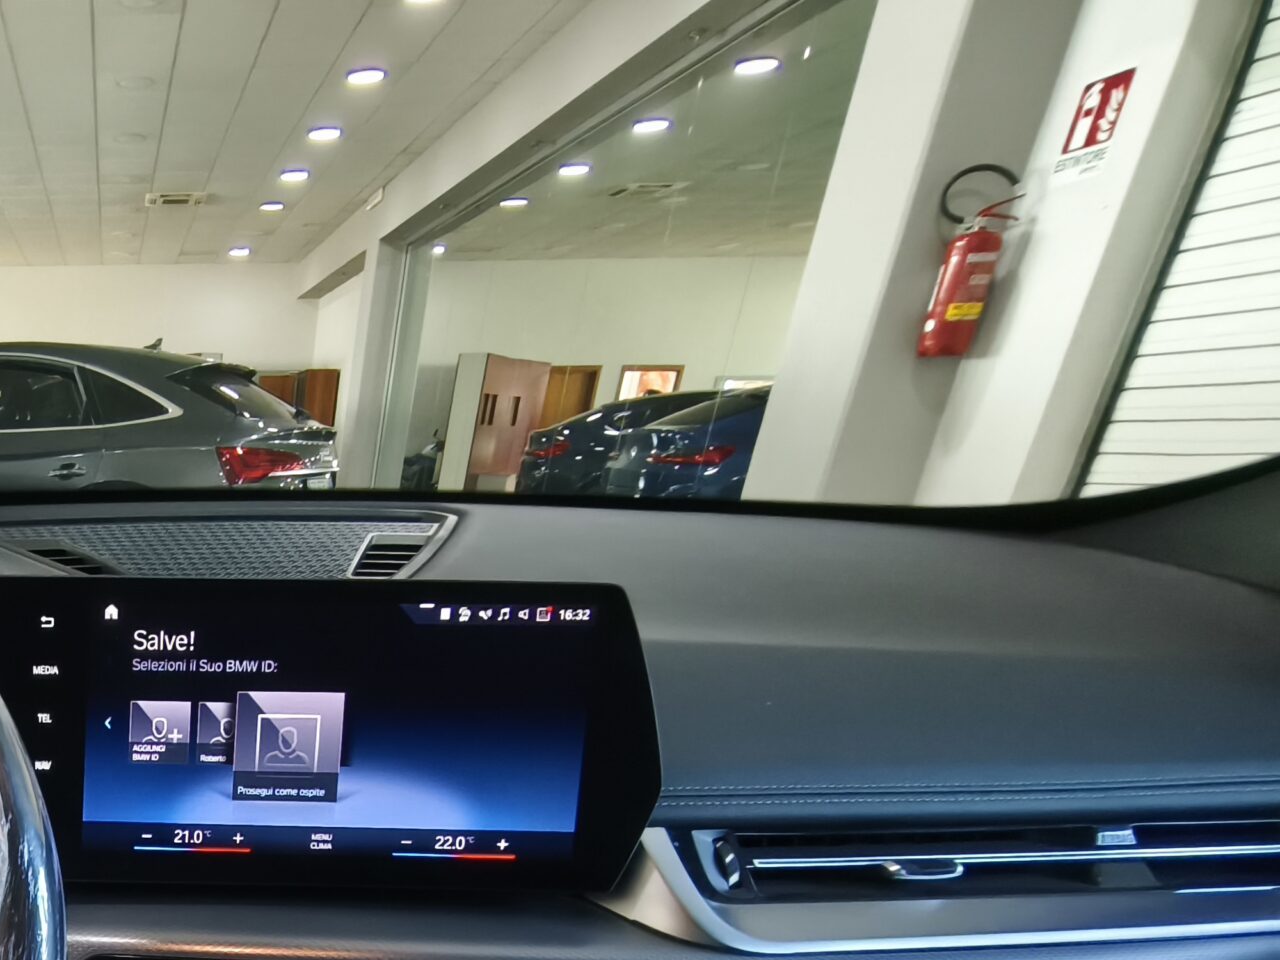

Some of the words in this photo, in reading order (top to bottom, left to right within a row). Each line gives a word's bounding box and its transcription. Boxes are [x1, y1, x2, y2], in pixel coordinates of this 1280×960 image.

[559, 609, 591, 620] 16:32
[133, 629, 196, 651] Salve!
[32, 665, 59, 675] MEDIA
[132, 658, 187, 671] Selezioni
[189, 659, 197, 671] il
[199, 659, 223, 672] Suo
[225, 660, 258, 672] BMW
[261, 660, 278, 673] ID:
[37, 713, 53, 723] TEL
[132, 753, 151, 761] BMW
[151, 753, 160, 761] ID
[237, 785, 273, 797] Prosegui
[275, 787, 298, 796] come
[299, 787, 325, 797] ospite
[173, 829, 203, 844] 21.0
[311, 833, 333, 841] MENU
[310, 842, 332, 850] CLIMA
[434, 836, 465, 850] 22.0
